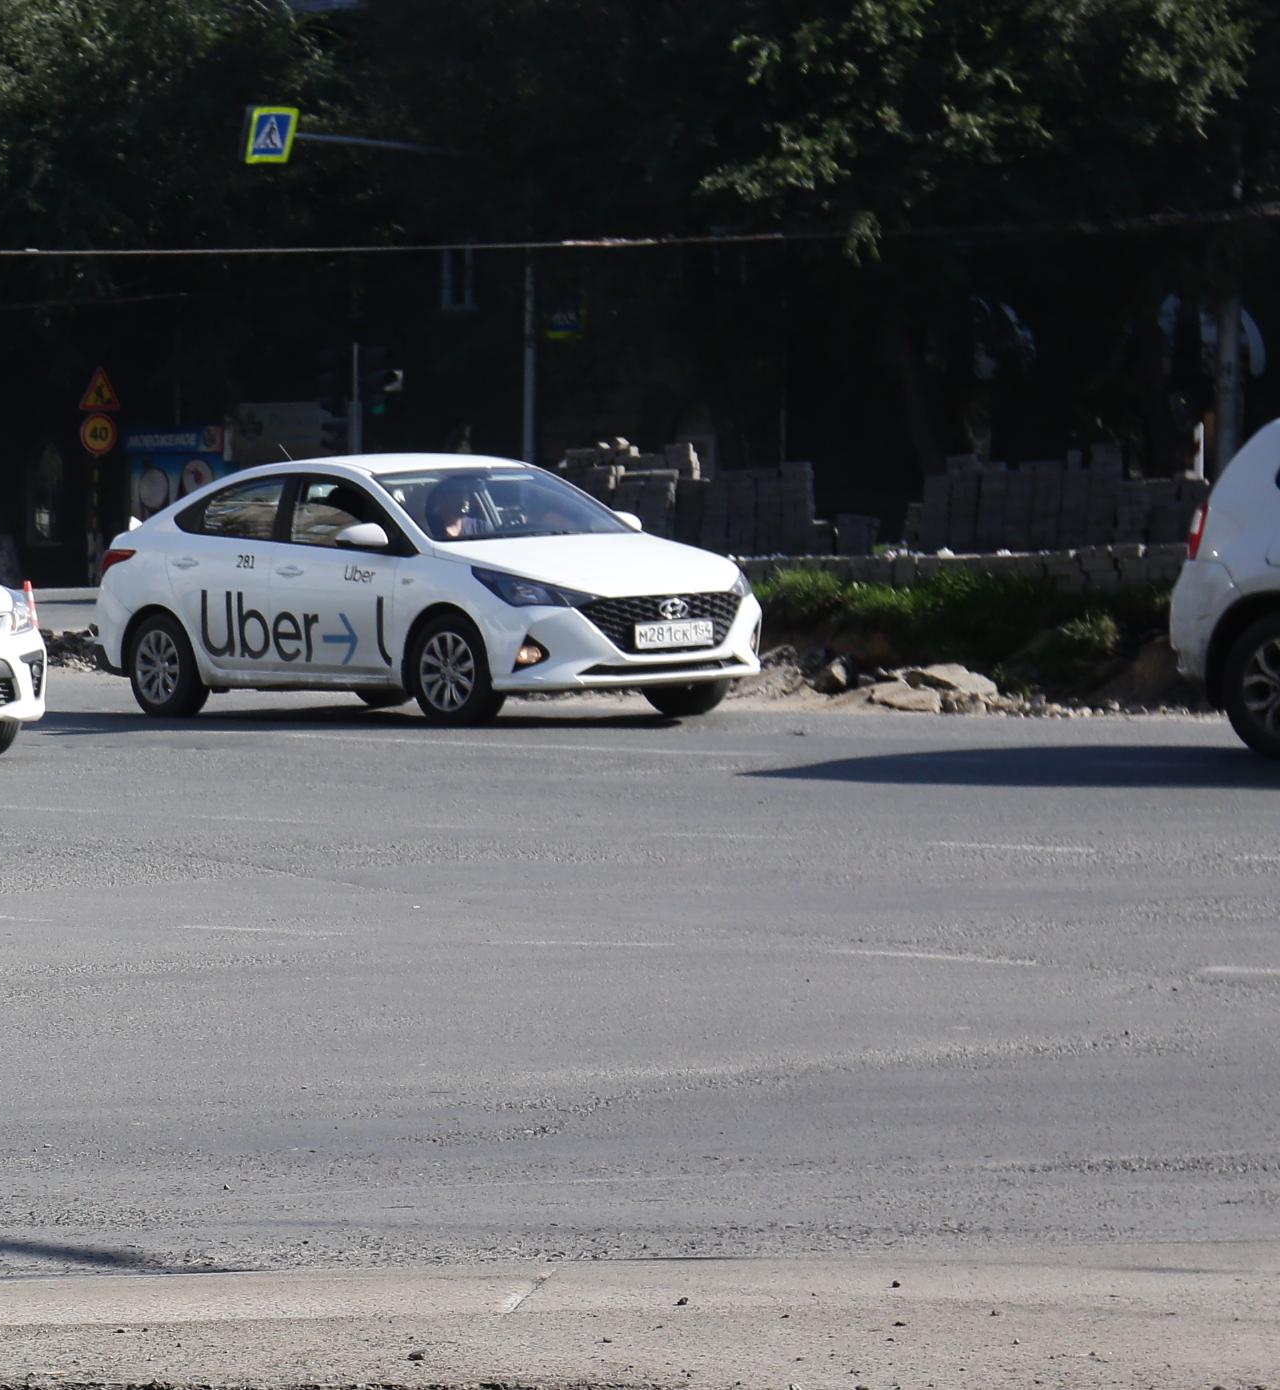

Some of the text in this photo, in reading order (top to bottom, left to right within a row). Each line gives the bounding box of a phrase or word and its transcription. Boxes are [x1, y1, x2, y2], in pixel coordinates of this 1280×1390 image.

[89, 426, 109, 442] 40
[236, 555, 255, 569] 281
[344, 564, 376, 584] Uber
[201, 589, 319, 663] Uber
